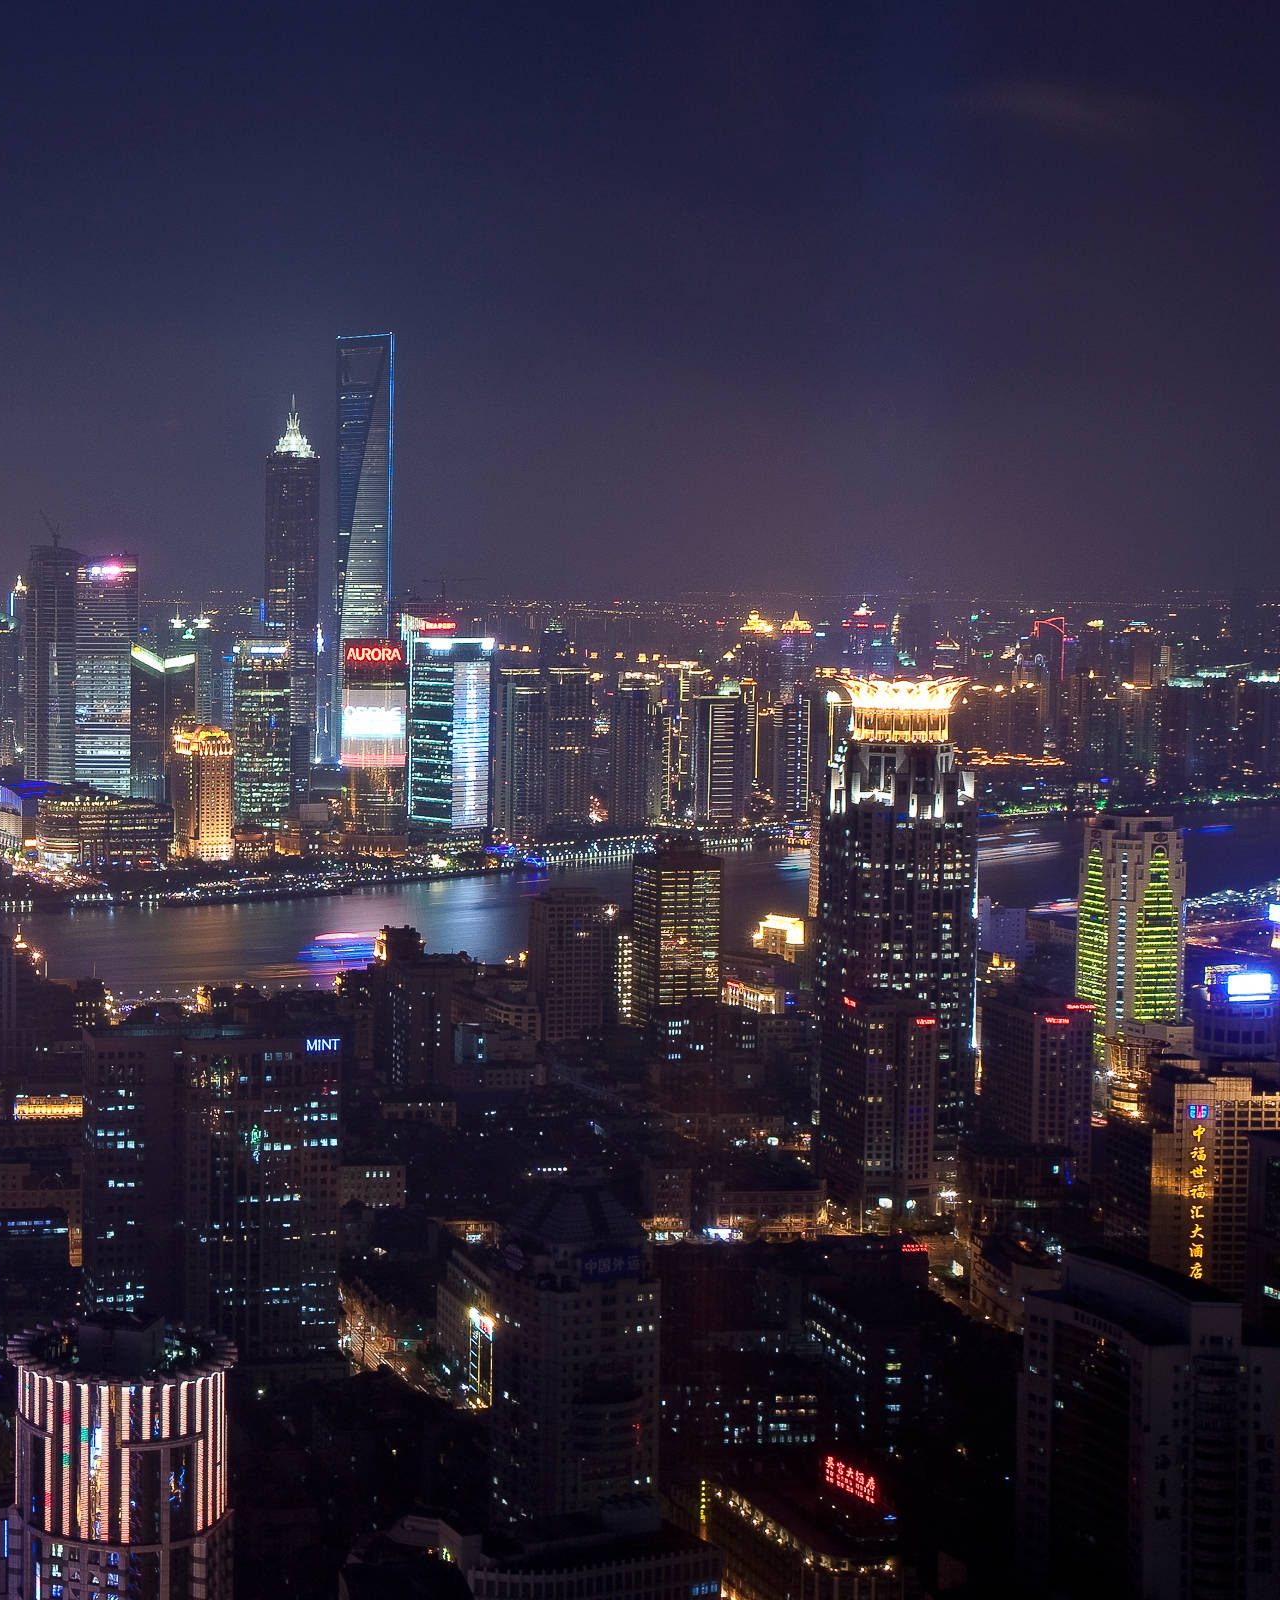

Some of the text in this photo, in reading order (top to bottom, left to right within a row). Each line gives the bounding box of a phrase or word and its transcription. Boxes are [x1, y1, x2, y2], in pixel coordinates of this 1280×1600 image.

[346, 647, 402, 661] AURORA
[306, 1038, 341, 1052] MINT
[1189, 1124, 1208, 1280] 中福世福汇大酒店
[584, 1256, 641, 1273] 中国外运
